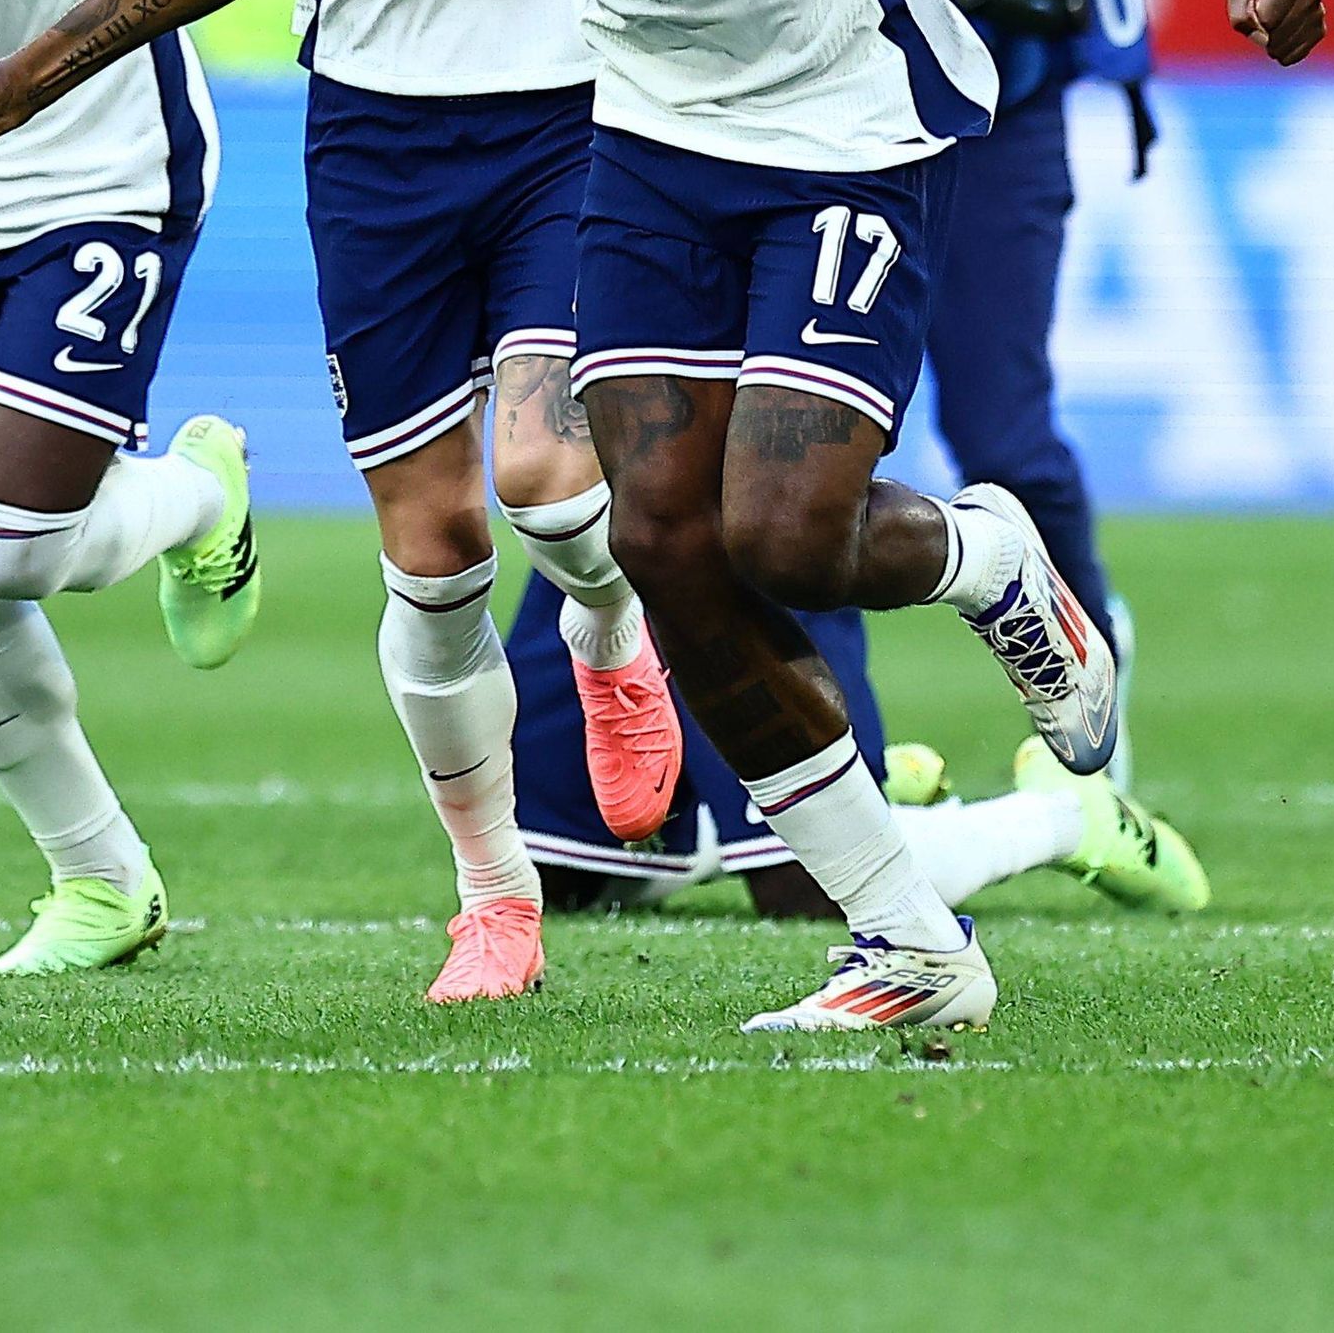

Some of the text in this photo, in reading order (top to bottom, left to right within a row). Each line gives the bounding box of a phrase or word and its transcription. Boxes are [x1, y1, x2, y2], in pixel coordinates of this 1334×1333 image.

[55, 241, 162, 354] 21
[812, 206, 901, 314] 17
[881, 969, 957, 987] F50
